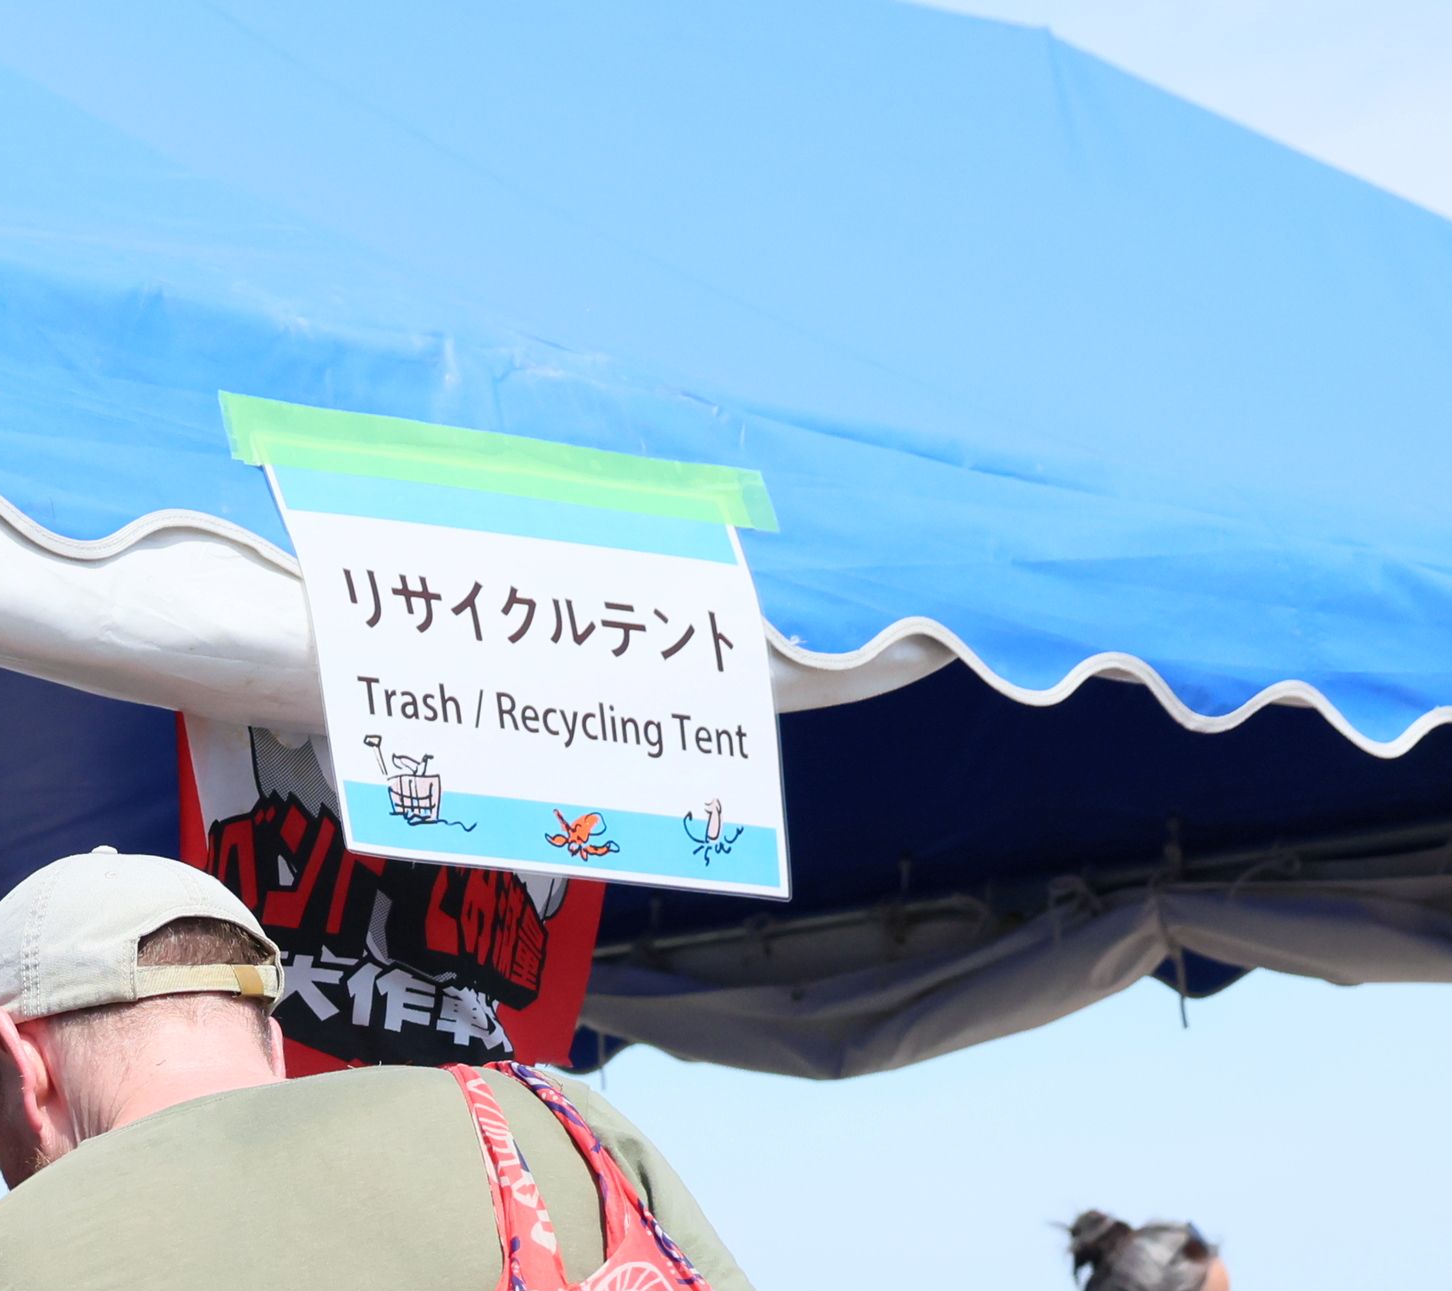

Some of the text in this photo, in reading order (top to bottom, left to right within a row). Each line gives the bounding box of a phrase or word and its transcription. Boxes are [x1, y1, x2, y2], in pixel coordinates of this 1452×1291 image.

[342, 568, 735, 673] リサイクルテント
[356, 676, 749, 761] Trash / Recycling Tent
